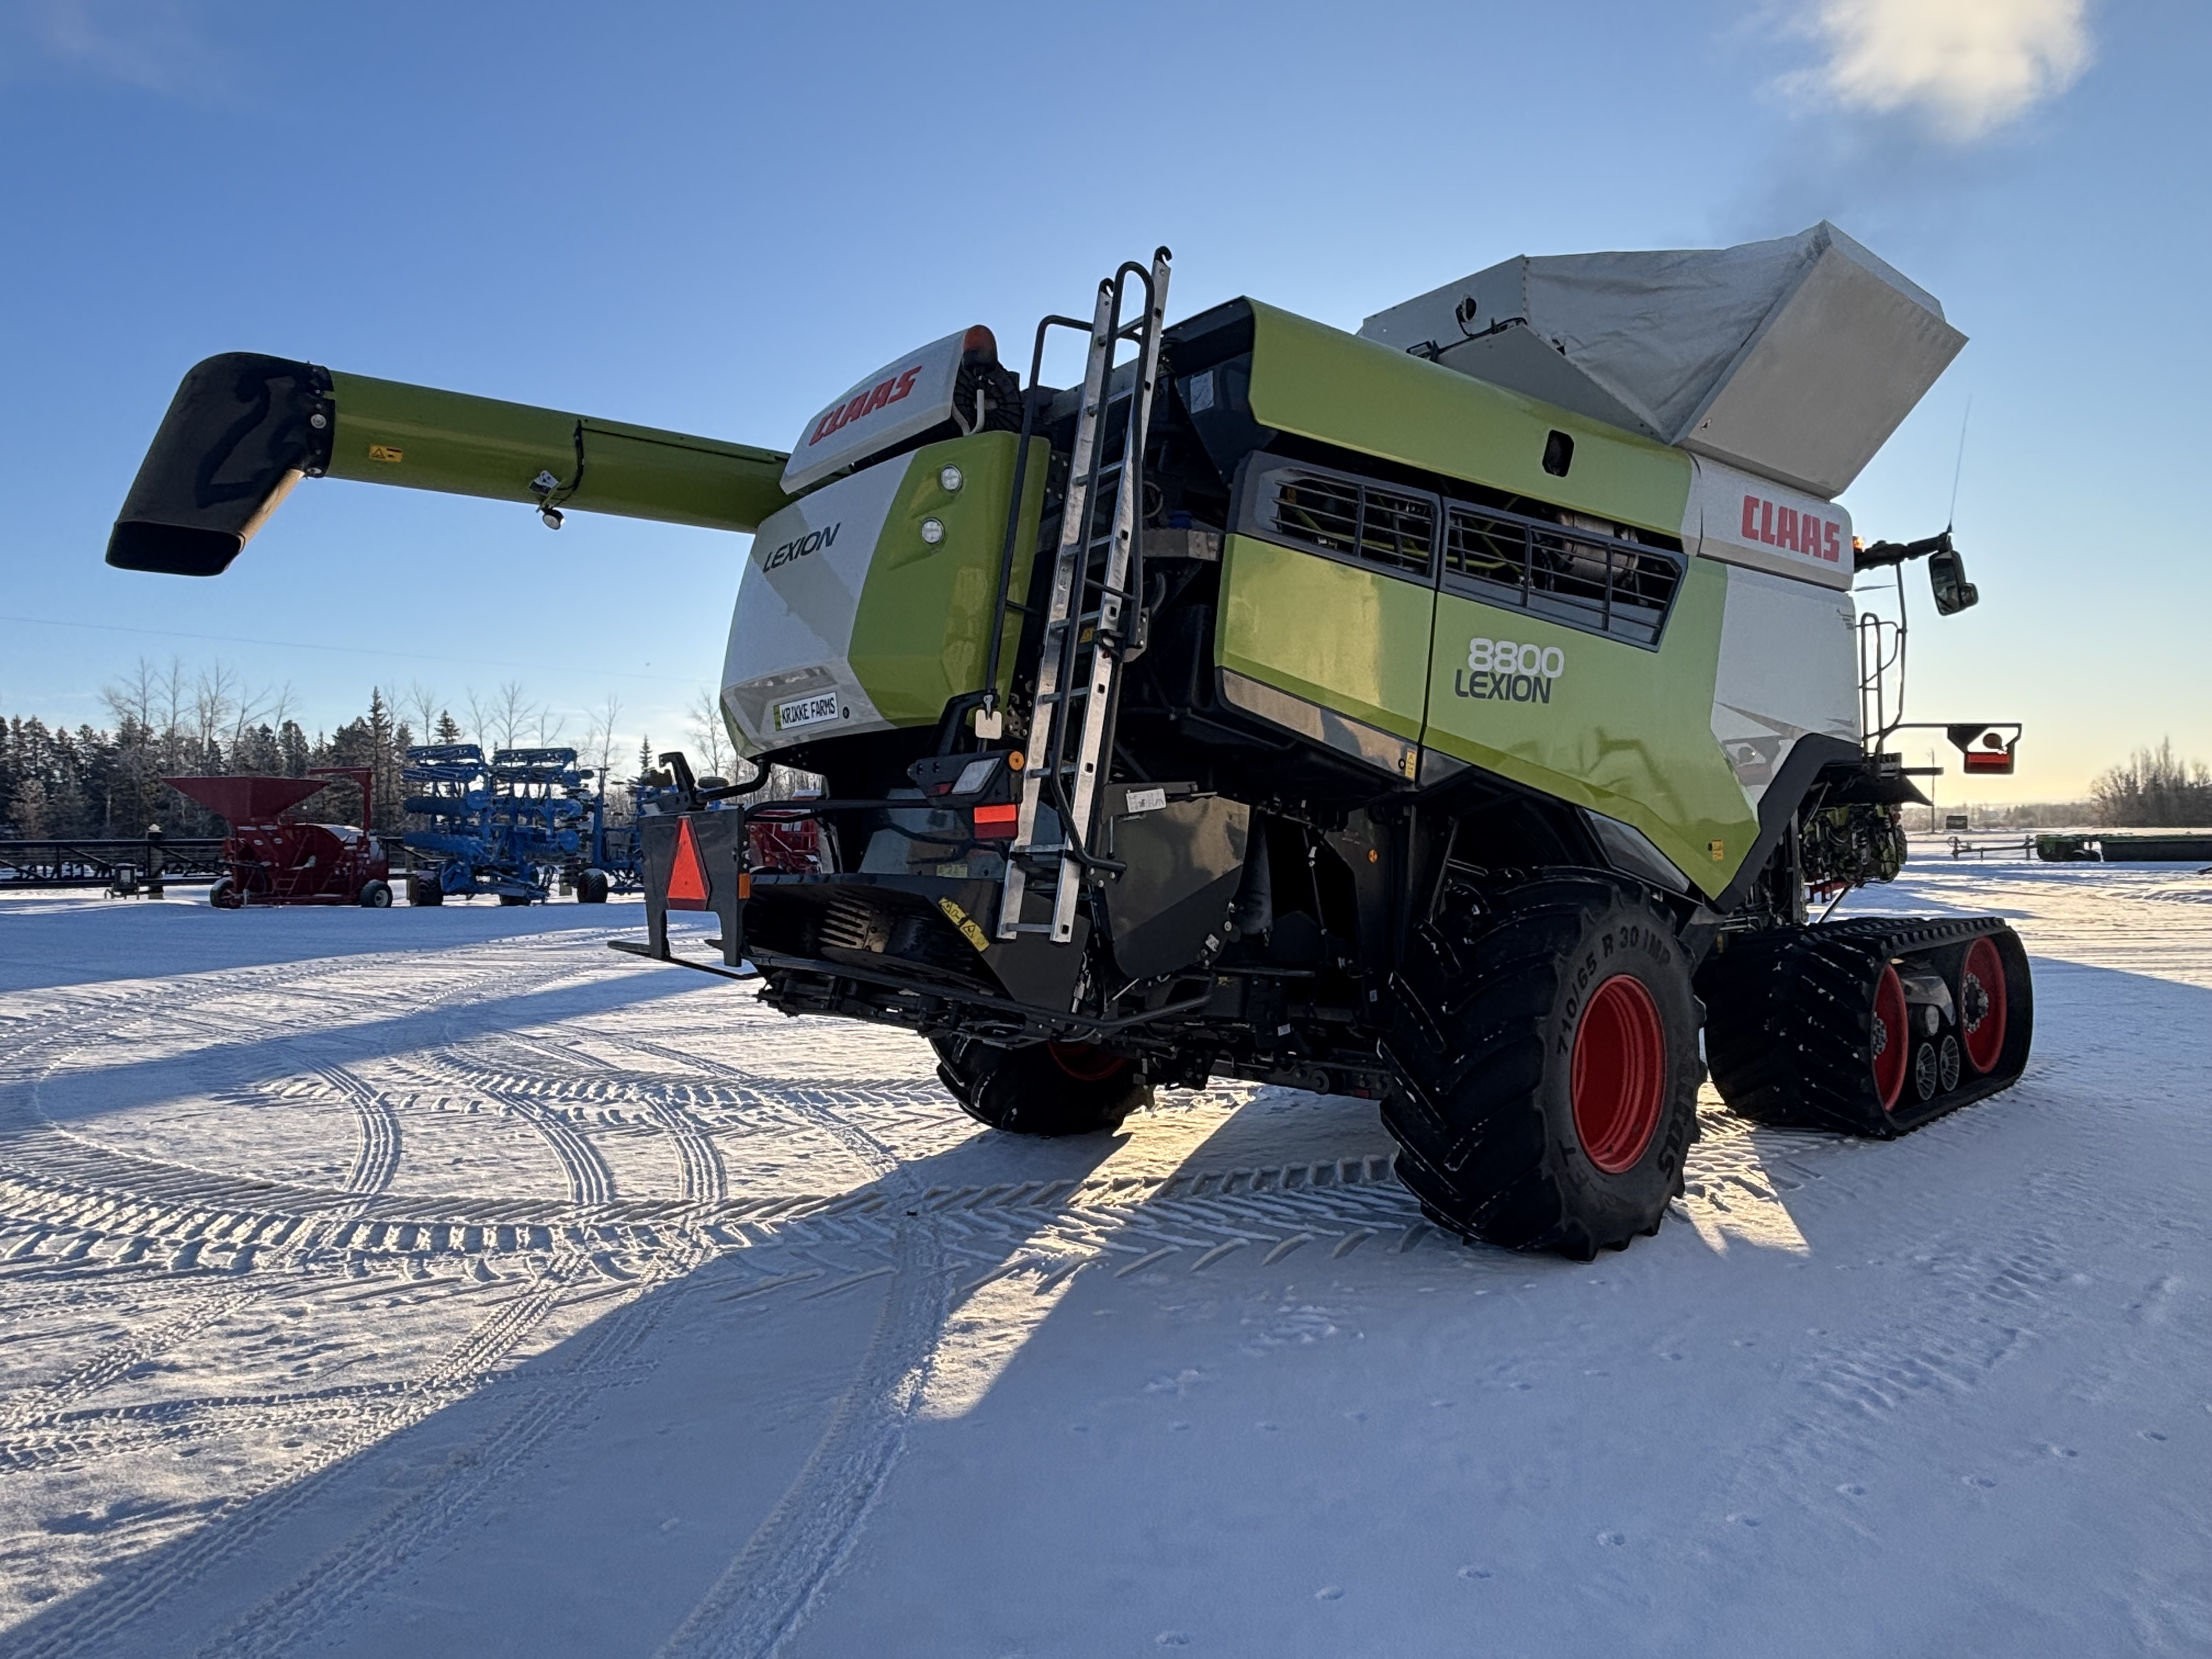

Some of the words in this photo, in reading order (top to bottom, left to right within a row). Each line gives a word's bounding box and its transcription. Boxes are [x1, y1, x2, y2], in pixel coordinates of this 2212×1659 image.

[809, 365, 923, 447] CLAAS
[763, 522, 842, 573] LEXION
[1741, 495, 1840, 563] CLAAS
[1468, 637, 1565, 679] 8800
[782, 703, 810, 725] KRIKKE
[810, 697, 835, 719] FARMS
[1455, 669, 1551, 704] LEXION
[1556, 950, 1598, 1055] 710/65
[1602, 933, 1614, 959] R
[1620, 925, 1639, 949] 30
